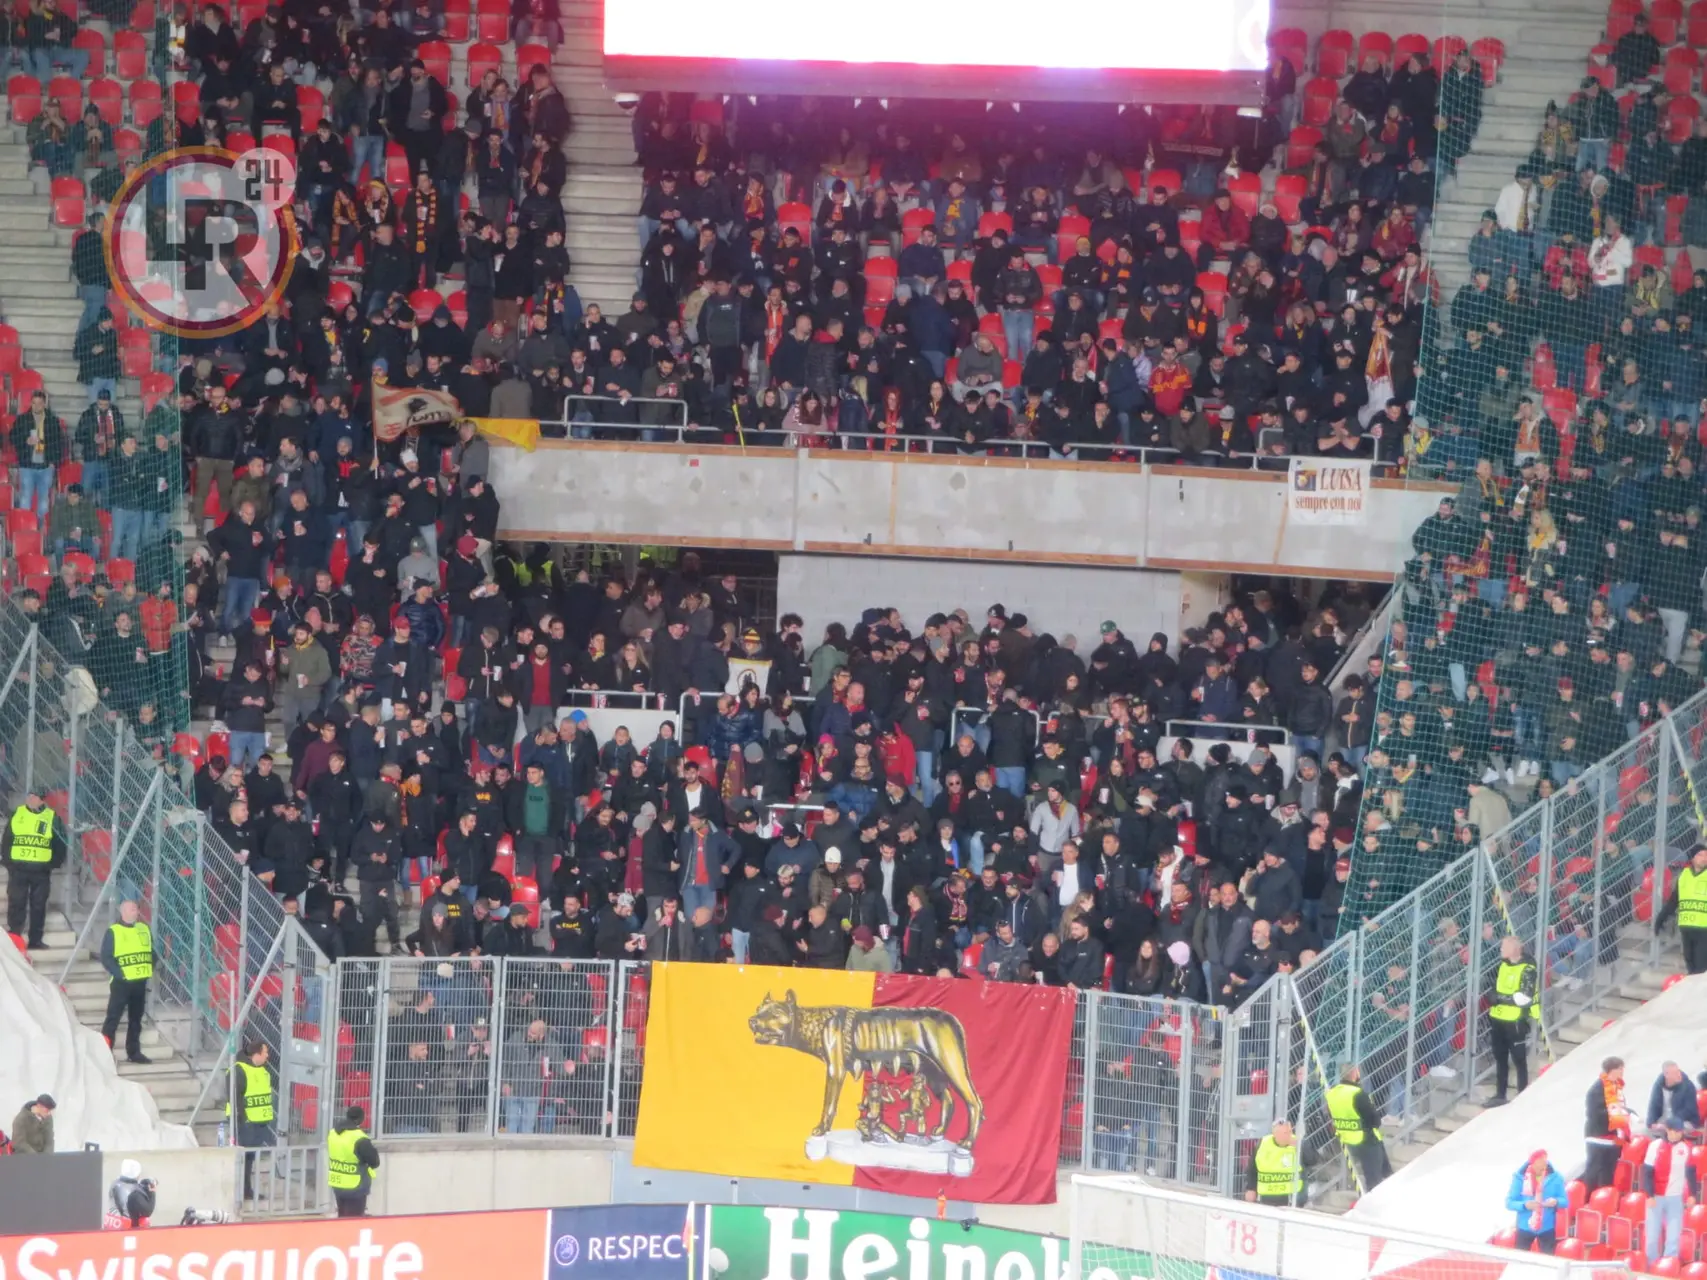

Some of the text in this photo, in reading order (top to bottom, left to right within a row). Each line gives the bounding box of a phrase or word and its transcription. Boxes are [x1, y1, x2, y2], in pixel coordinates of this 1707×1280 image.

[1320, 468, 1361, 491] LUISA
[1295, 496, 1328, 513] sempre
[1226, 1219, 1258, 1256] 18
